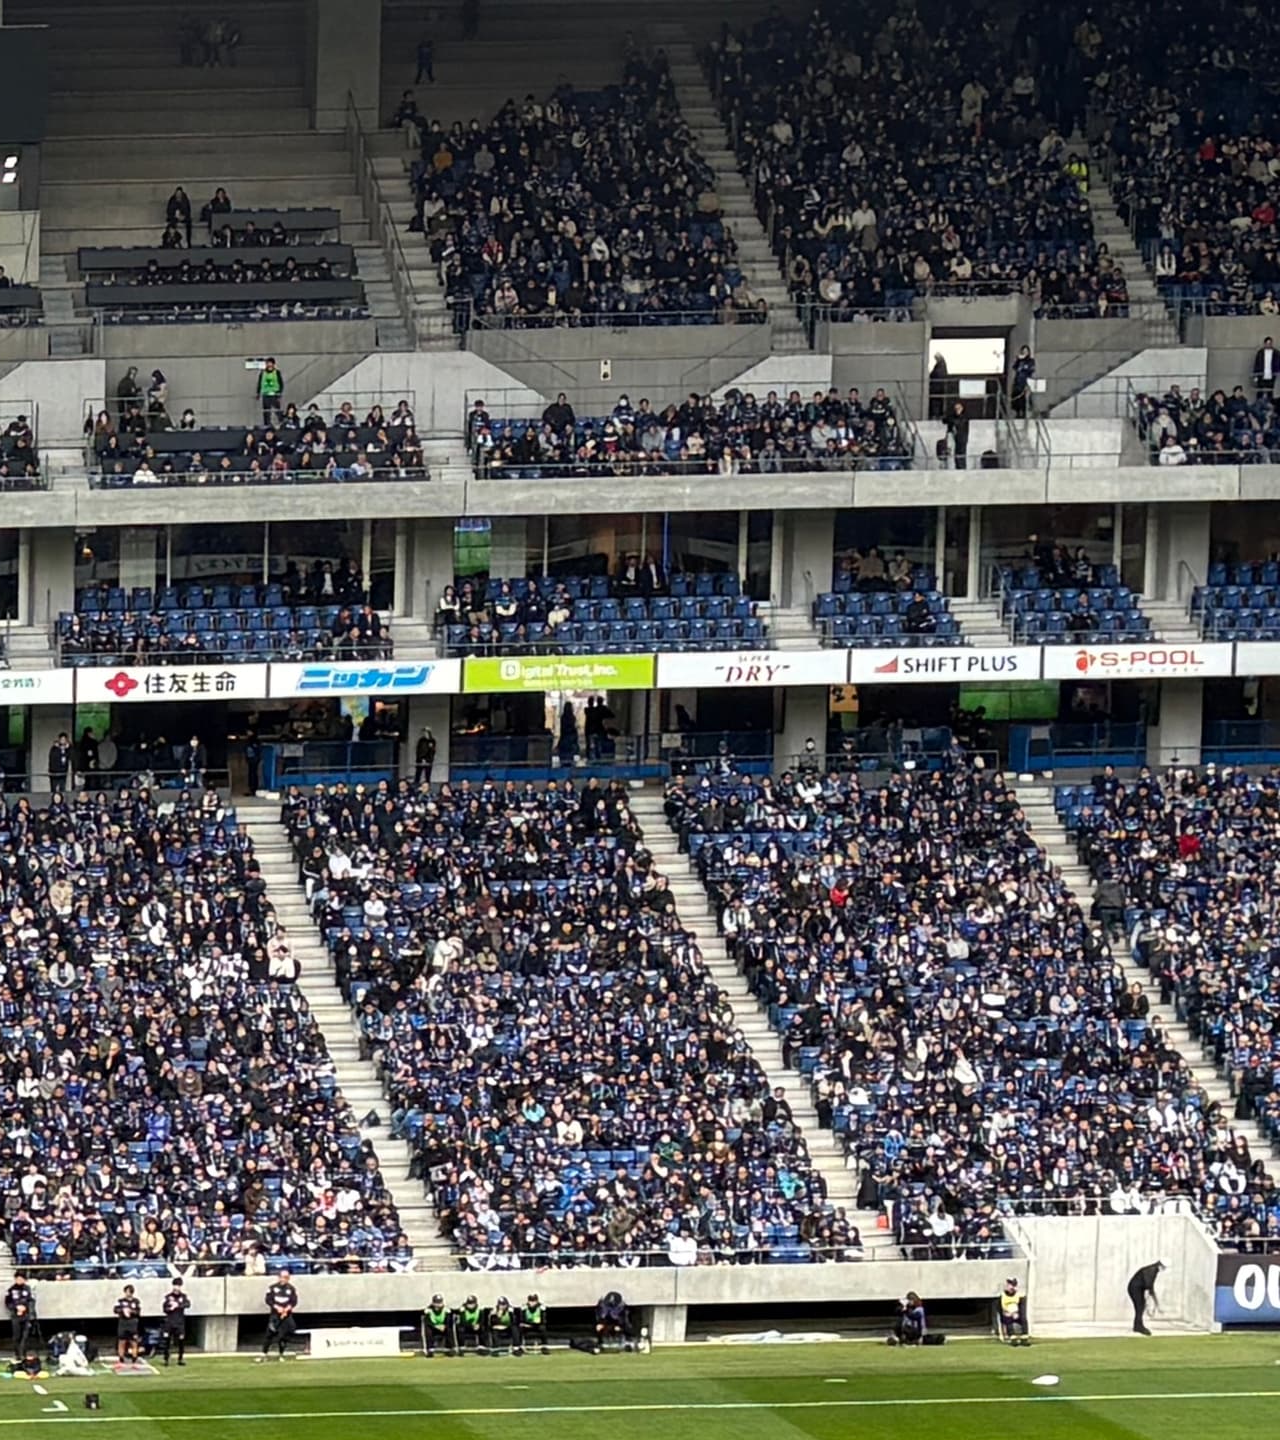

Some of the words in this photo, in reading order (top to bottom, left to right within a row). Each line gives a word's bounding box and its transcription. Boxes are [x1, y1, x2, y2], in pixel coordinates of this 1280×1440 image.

[903, 656, 961, 673] SHIFT
[968, 655, 1018, 672] PLUS
[1100, 650, 1205, 667] S-POOL
[144, 671, 237, 694] 住友生命
[298, 665, 431, 690] ニッカン
